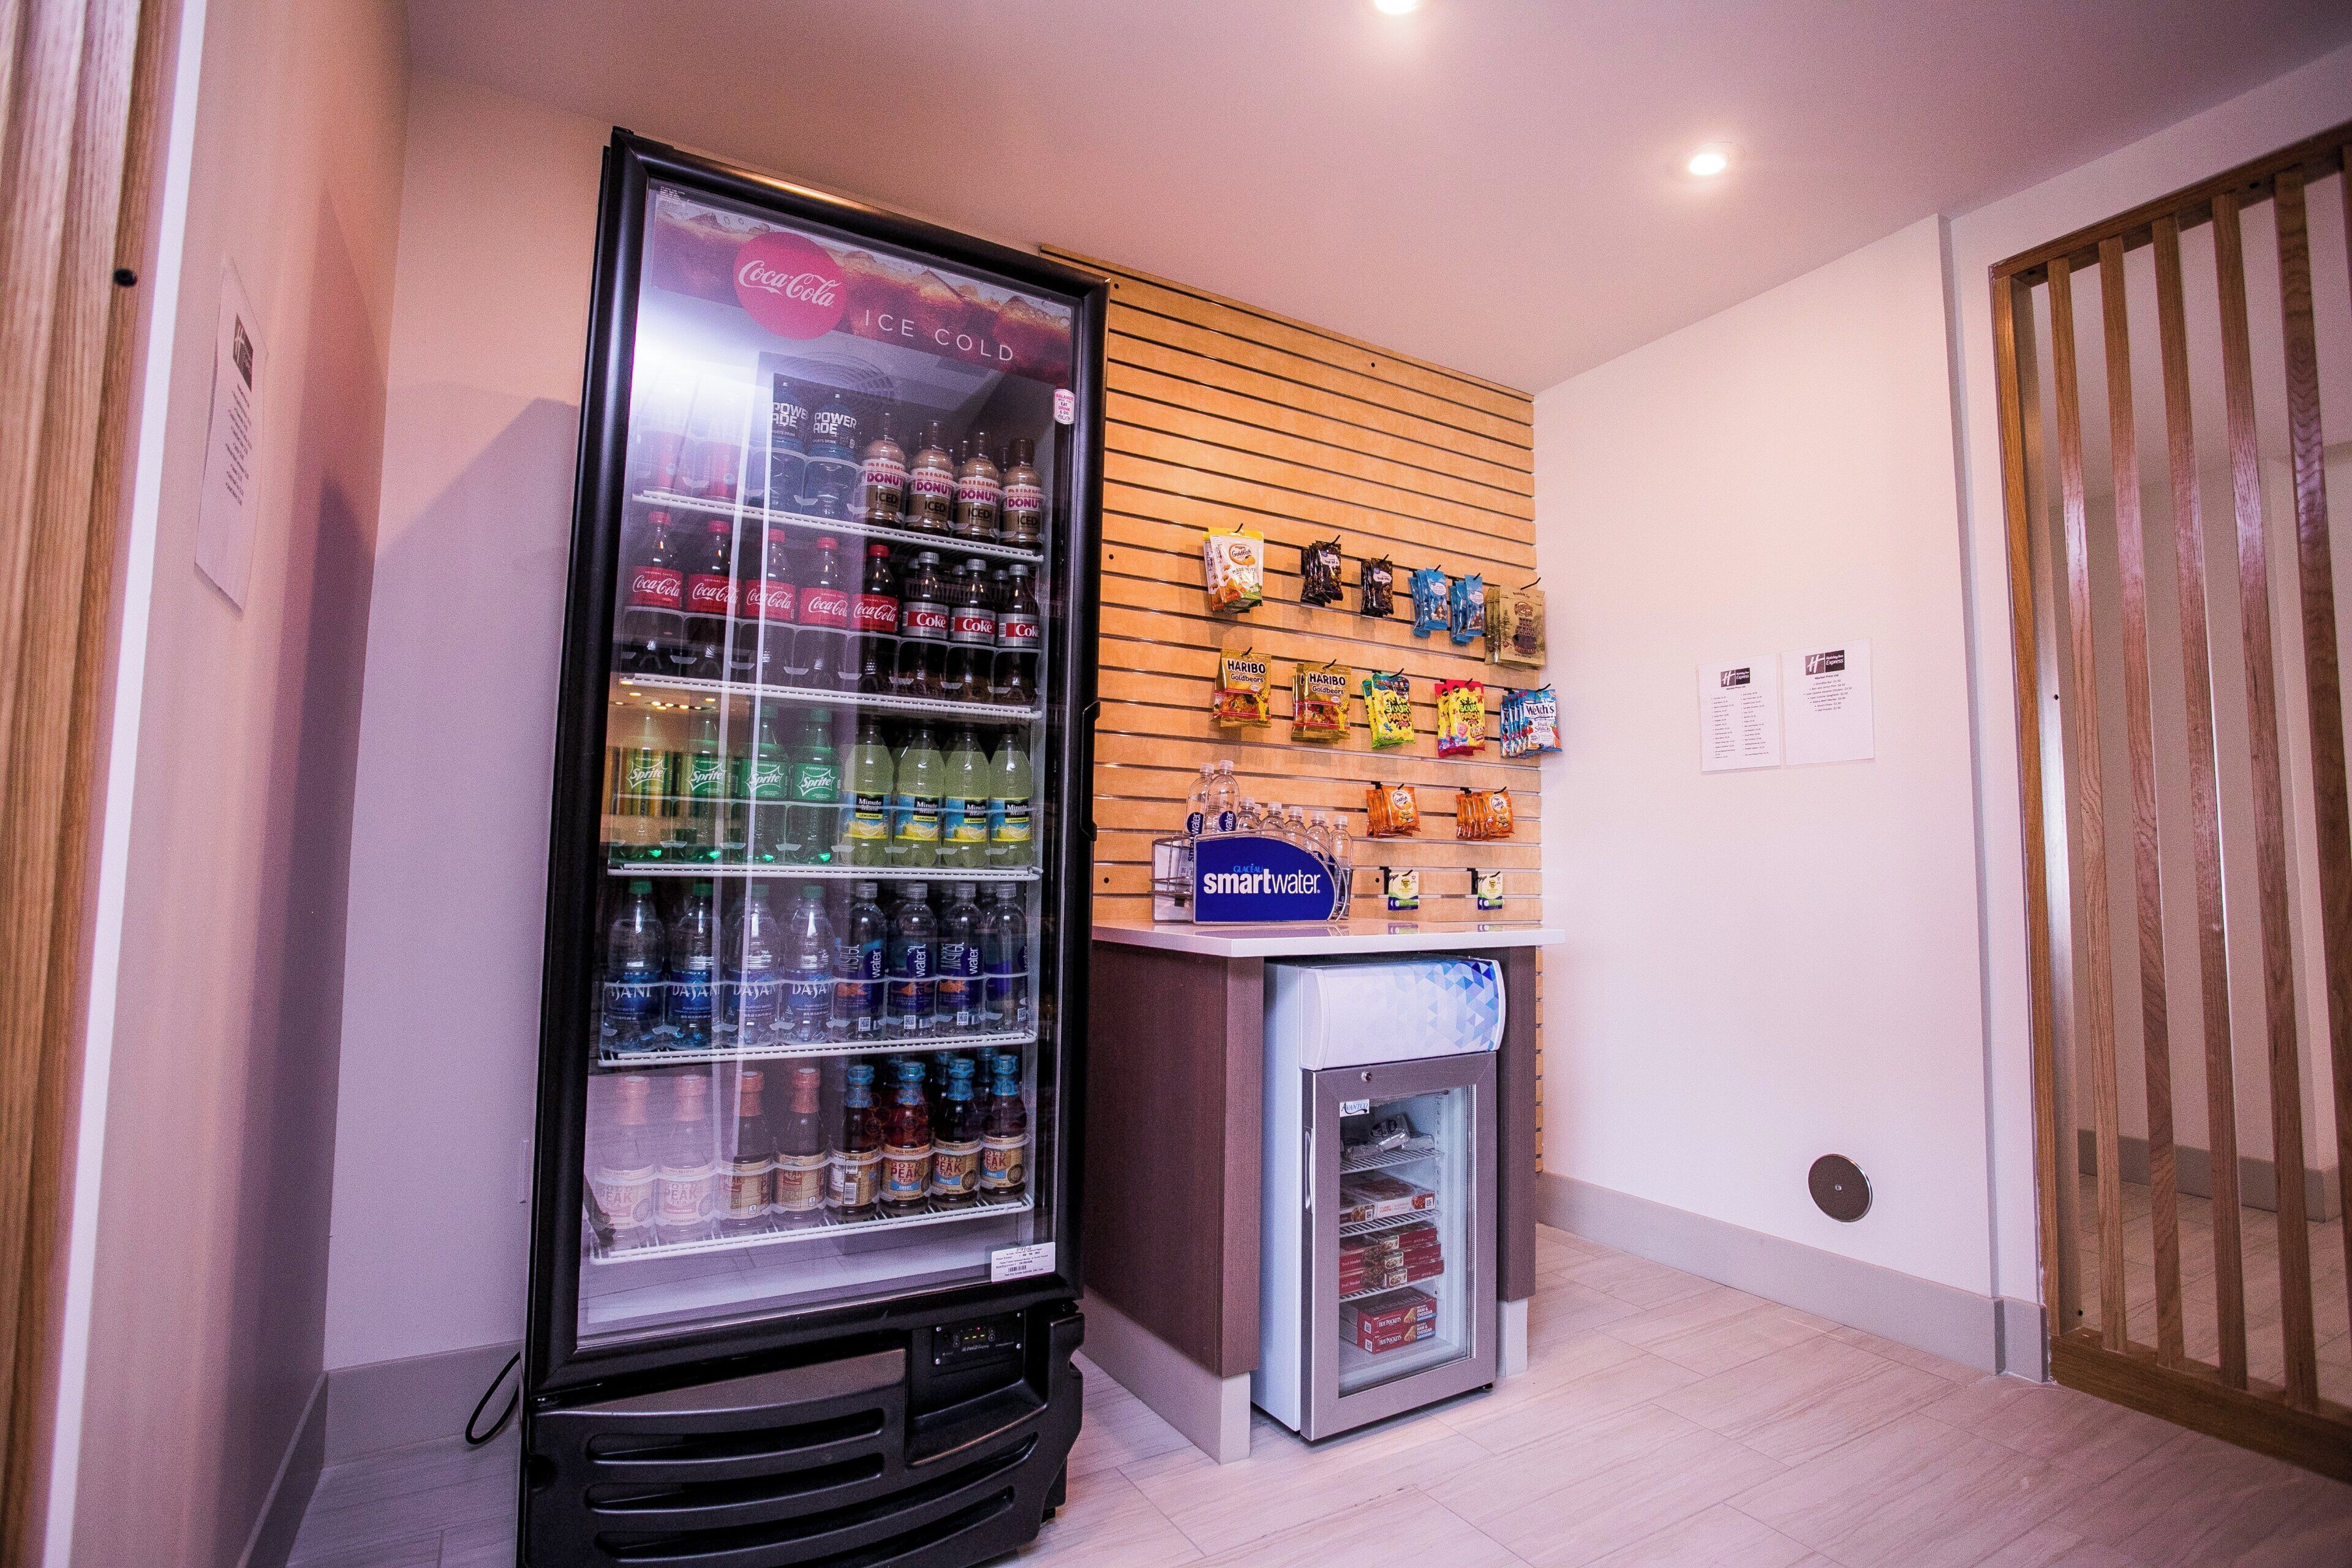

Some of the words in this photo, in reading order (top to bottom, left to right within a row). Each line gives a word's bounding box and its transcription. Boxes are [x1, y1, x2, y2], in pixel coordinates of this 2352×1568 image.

[738, 260, 842, 306] Coca-Cola
[865, 309, 914, 337] ICE
[935, 328, 1013, 361] COLD
[772, 402, 809, 420] POWE
[772, 413, 797, 426] ADE
[814, 412, 857, 429] POWER
[813, 423, 839, 435] ADE
[876, 492, 898, 504] ICED
[924, 500, 946, 513] ICED
[1232, 549, 1252, 557] Goldfish
[632, 575, 682, 597] Coca-Cola
[692, 583, 739, 604] Coca-Cola
[747, 589, 794, 609] Coca-Cola
[853, 602, 898, 622] Coca-Cola
[916, 613, 946, 628] Coke
[962, 618, 992, 633] Coke
[1227, 660, 1266, 674] HARIBO
[1231, 673, 1264, 684] Goldbears
[1309, 673, 1346, 686] HARIBO
[1312, 685, 1344, 695] Goldbears
[1385, 704, 1409, 714] SOUR
[1526, 704, 1555, 715] Welch's
[1386, 713, 1412, 723] PATCH
[1461, 712, 1481, 720] PATCH
[630, 768, 665, 781] Sprite
[691, 770, 723, 783] Sprite
[748, 773, 780, 785] Sprite
[801, 776, 832, 788] Sprite
[1233, 864, 1264, 873] GLACÉAU
[1341, 1102, 1368, 1114] AVANTCO
[935, 1160, 962, 1173] PEAK
[986, 1157, 1007, 1167] EAK
[890, 1167, 922, 1178] PEAK
[1386, 1316, 1401, 1325] POCKETS
[1386, 1335, 1402, 1343] POCKETS
